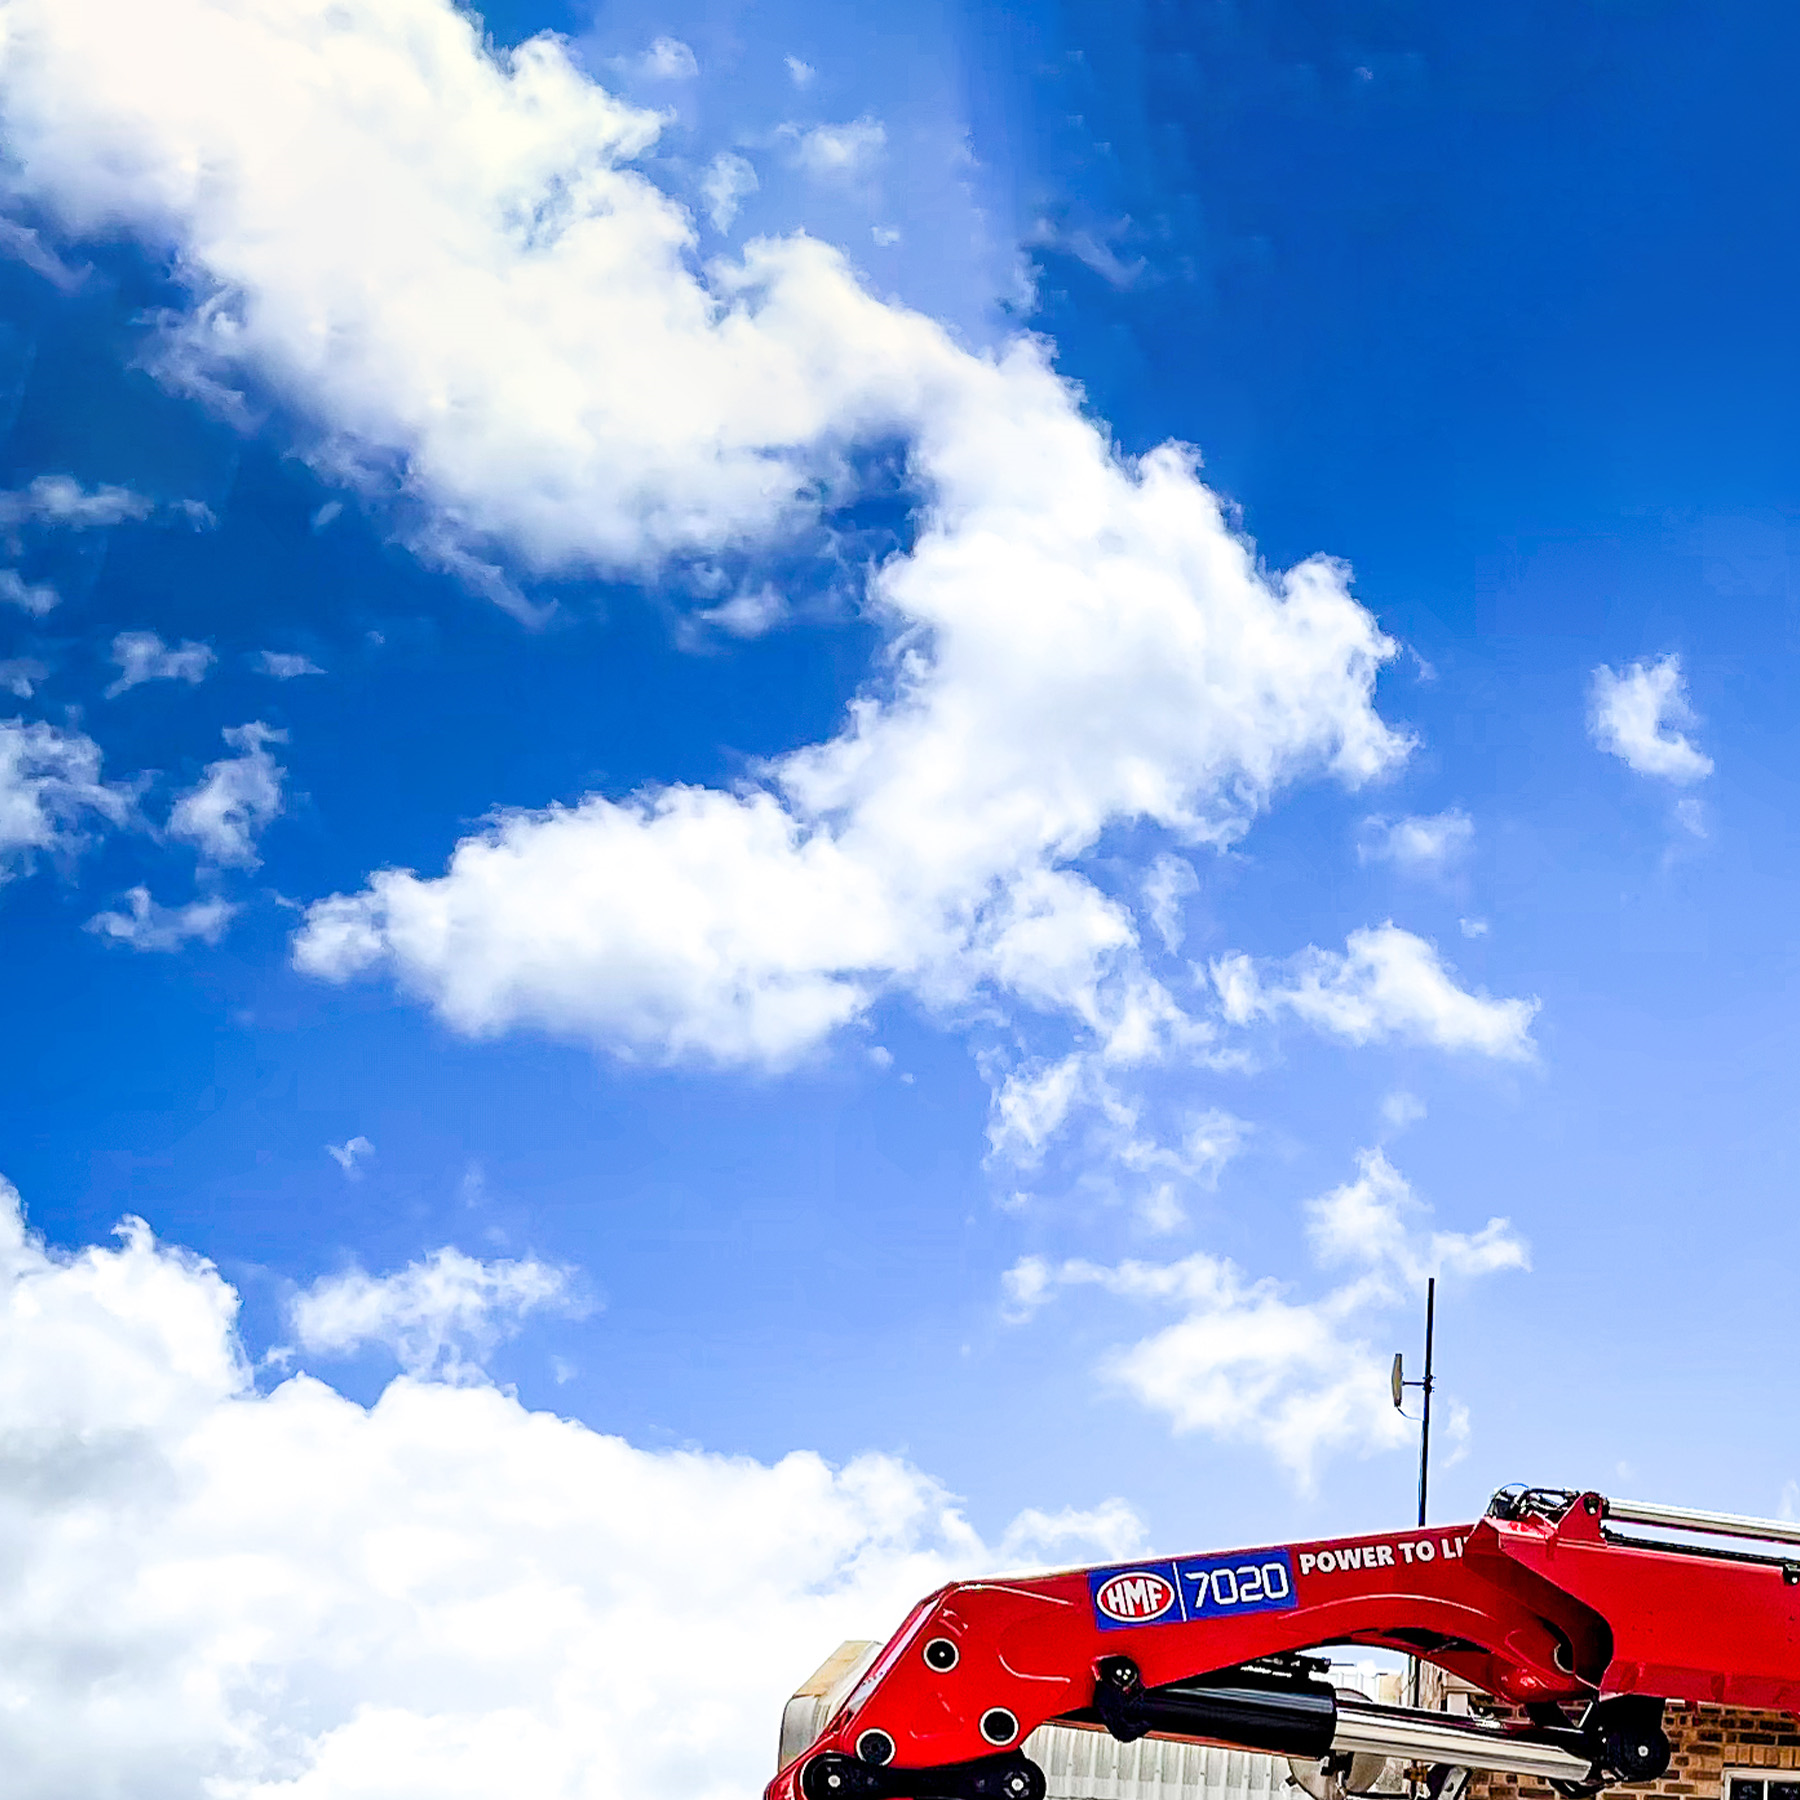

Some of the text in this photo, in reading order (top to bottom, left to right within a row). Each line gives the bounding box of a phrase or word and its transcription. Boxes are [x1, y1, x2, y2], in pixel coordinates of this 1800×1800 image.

[1299, 1536, 1469, 1575] POWER TO LI
[1105, 1563, 1289, 1616] HMF 7020
